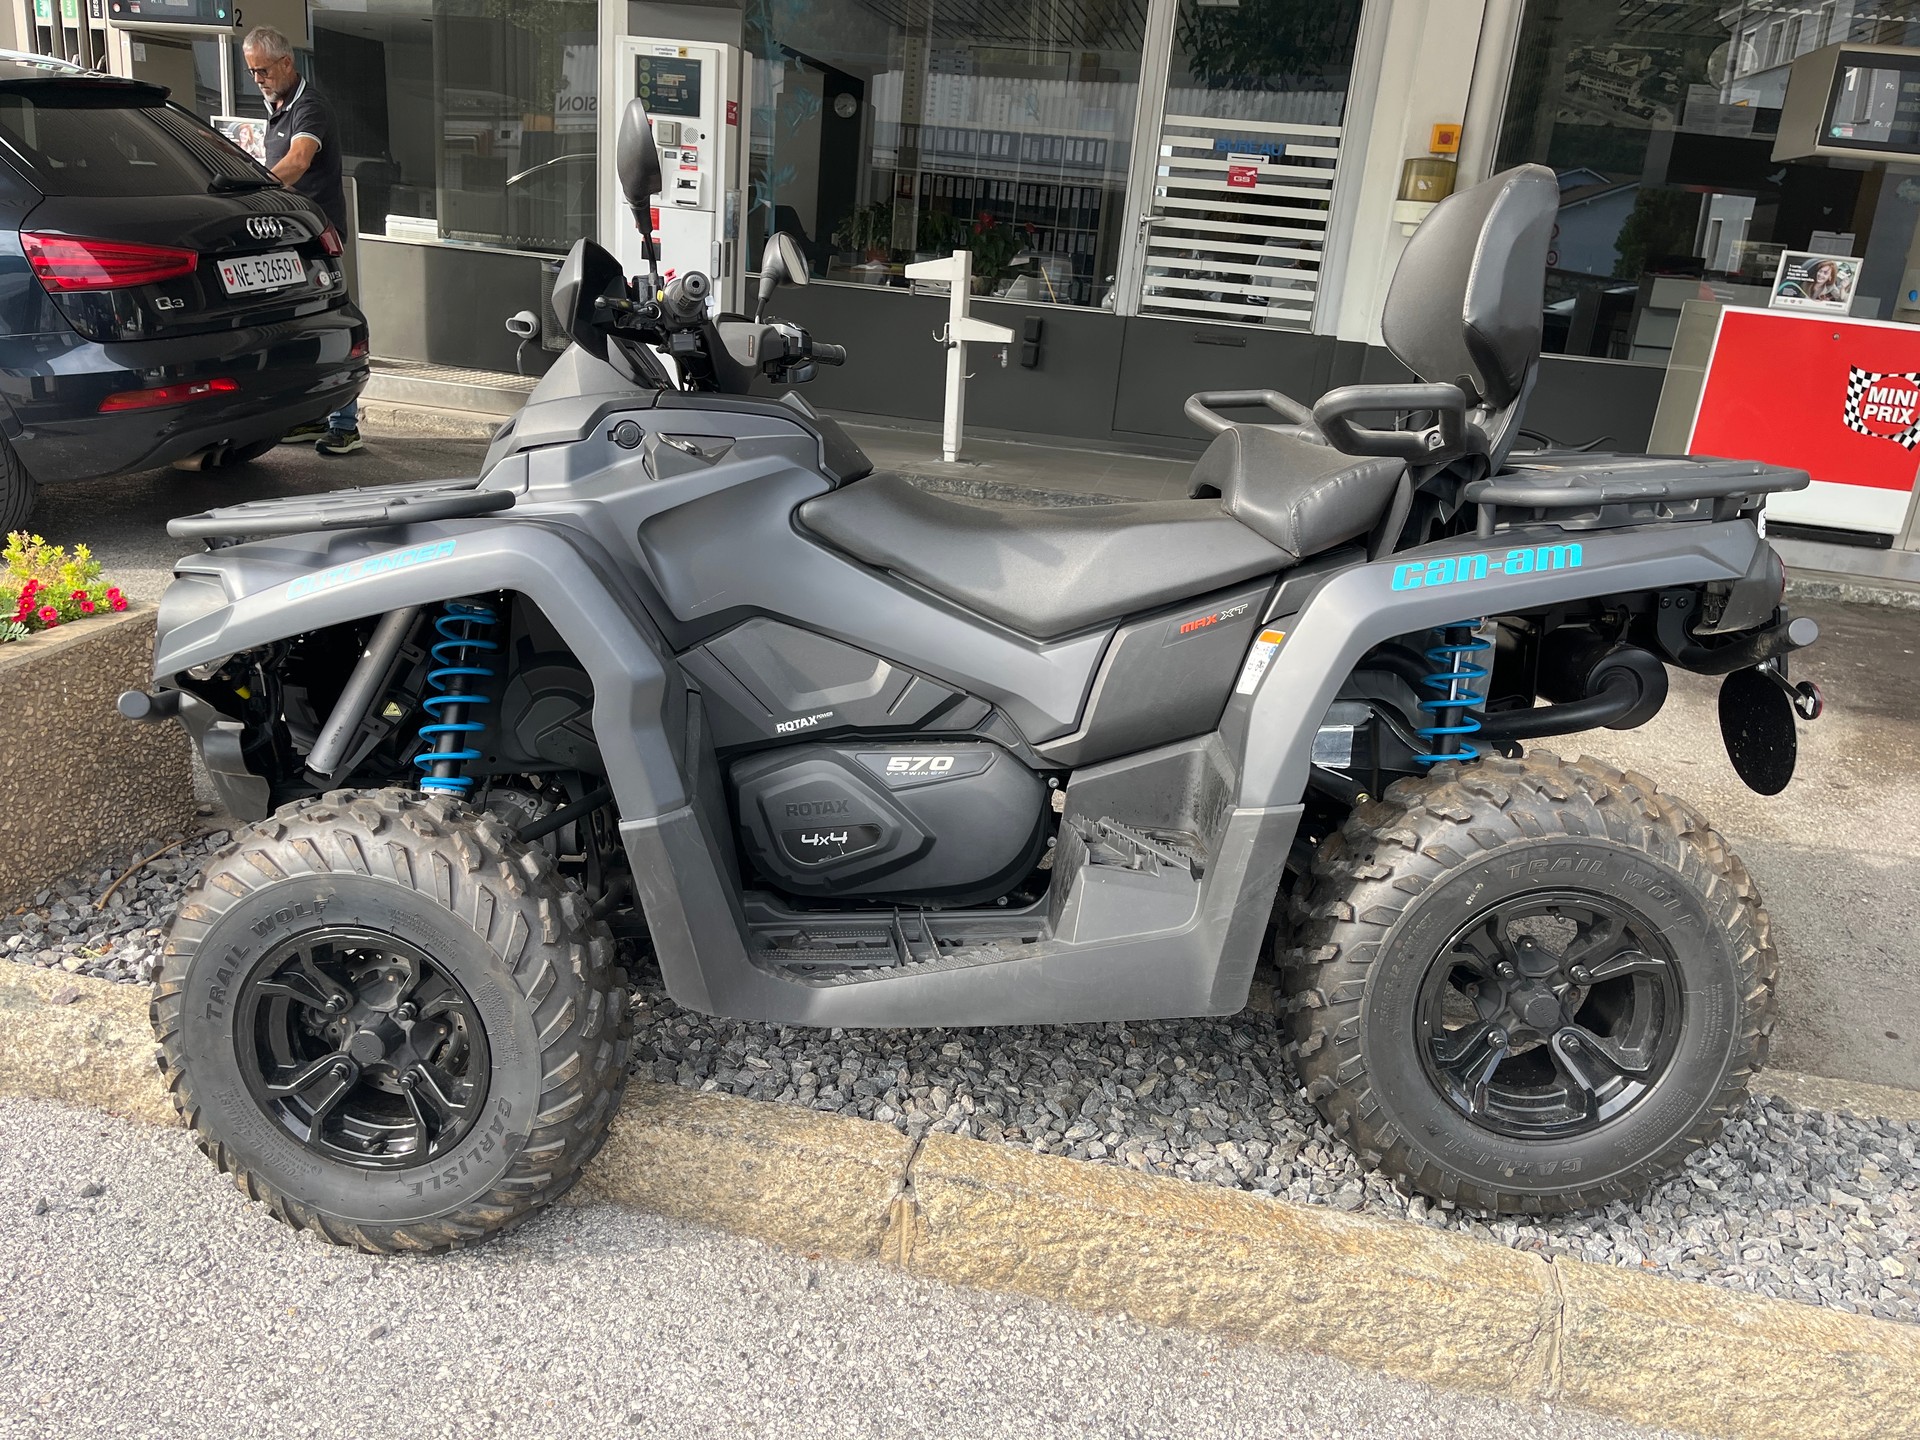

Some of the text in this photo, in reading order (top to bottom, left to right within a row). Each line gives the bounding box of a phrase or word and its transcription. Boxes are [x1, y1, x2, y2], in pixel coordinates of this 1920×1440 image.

[234, 8, 244, 28] 2
[1845, 67, 1858, 91] 1
[1885, 82, 1895, 90] Fr.
[1215, 138, 1284, 156] BUREAU
[233, 264, 254, 287] NE
[255, 258, 293, 284] 52659
[155, 296, 185, 310] Q3
[1867, 386, 1919, 407] MINI
[1862, 404, 1914, 425] PRIX
[286, 539, 457, 601] OUTLANDER
[1391, 543, 1583, 592] can-am
[1219, 603, 1249, 621] XT
[775, 715, 818, 733] ROTAX
[886, 756, 955, 771] 570
[785, 800, 850, 817] ROTAX
[801, 831, 848, 846] 4x4
[1506, 857, 1701, 928] TRAIL WOLF
[206, 898, 330, 1020] TRAIL WOLF
[404, 1097, 512, 1200] CARLISLE
[1425, 1124, 1583, 1177] CARLISLE
